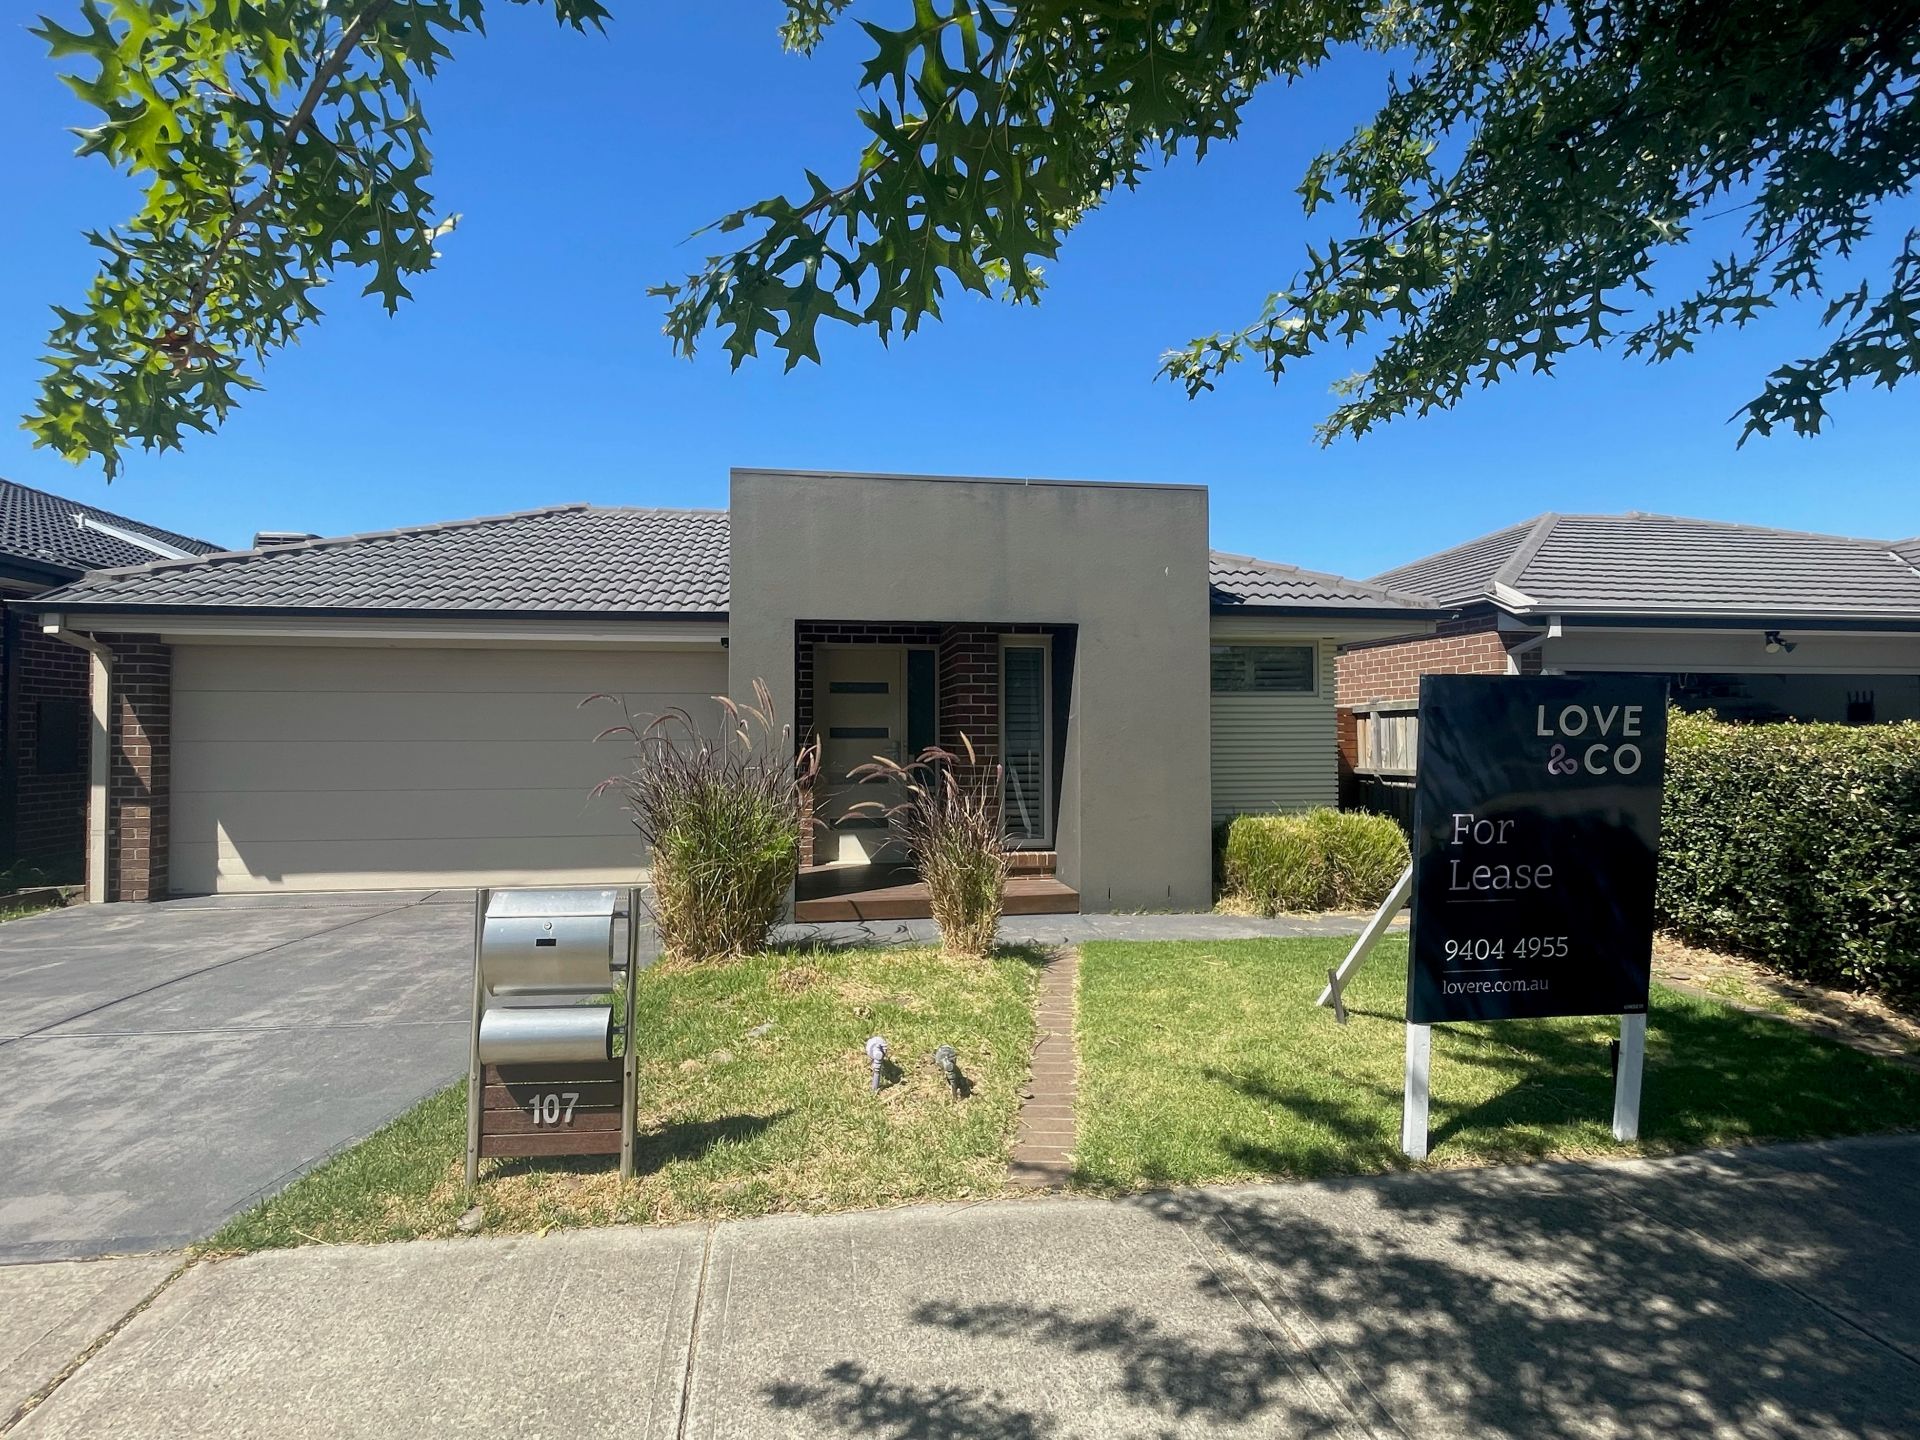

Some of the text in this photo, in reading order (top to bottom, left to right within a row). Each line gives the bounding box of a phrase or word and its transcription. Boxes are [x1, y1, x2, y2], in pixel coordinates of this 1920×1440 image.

[1537, 705, 1643, 737] LOVE
[1450, 813, 1515, 845] For
[1449, 859, 1553, 891] Lease
[1444, 936, 1569, 961] 9404 4955
[1442, 978, 1549, 994] lovere.com.au
[528, 1092, 580, 1124] 107
